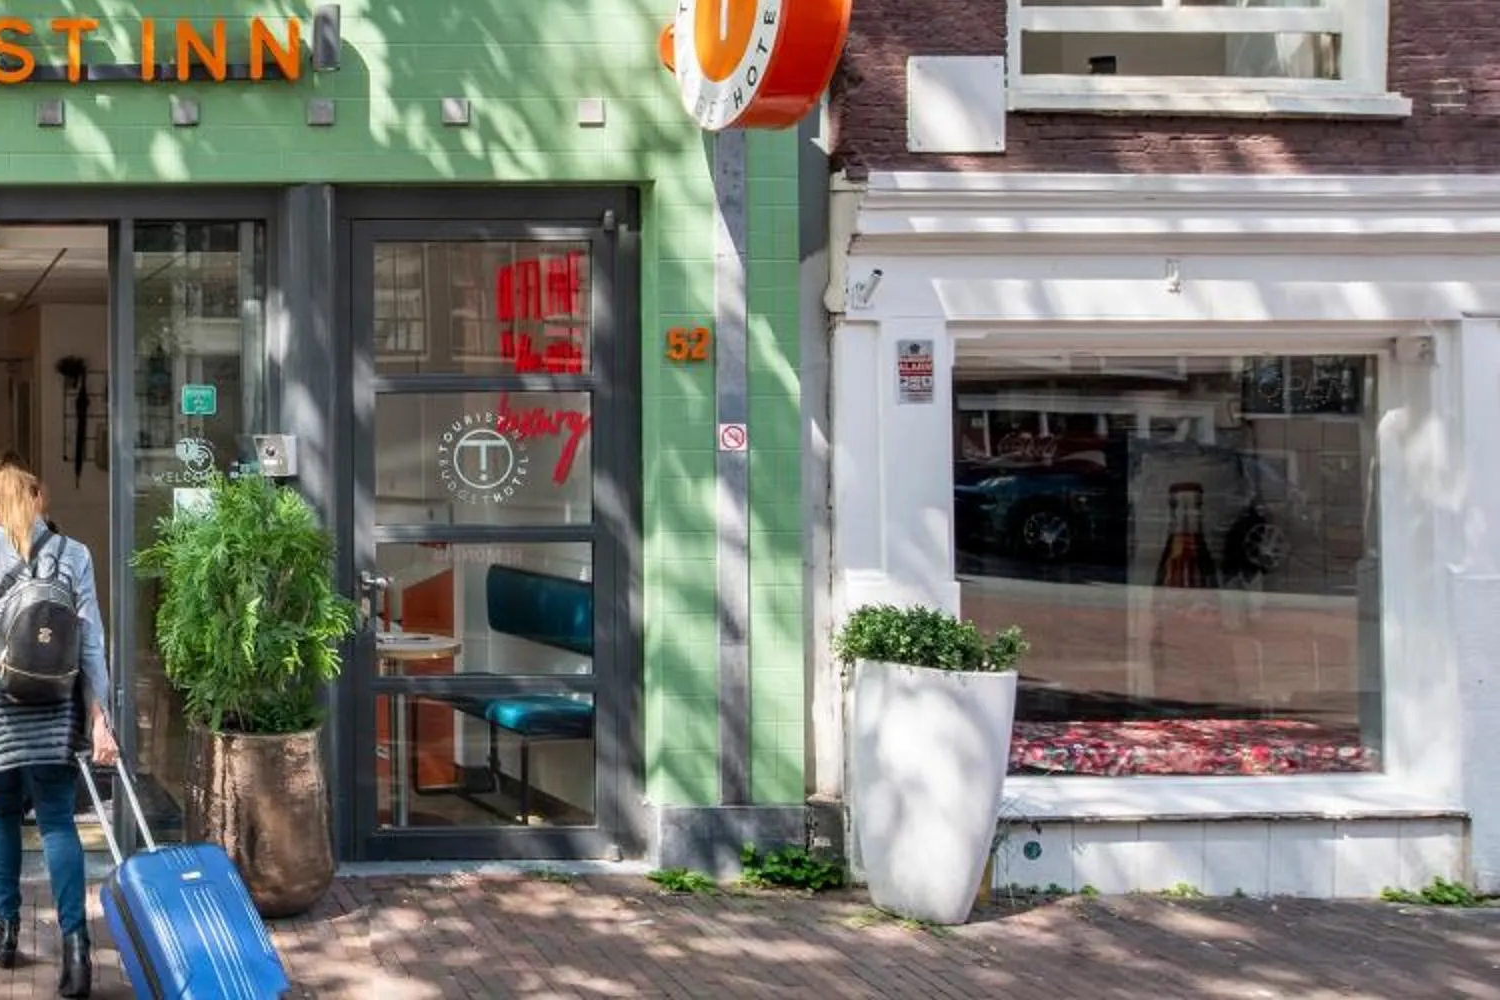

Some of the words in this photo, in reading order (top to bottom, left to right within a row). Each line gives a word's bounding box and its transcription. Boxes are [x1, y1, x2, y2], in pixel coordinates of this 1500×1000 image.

[141, 18, 301, 83] INN
[667, 327, 710, 361] 52
[438, 412, 506, 453] TOURIST
[493, 455, 530, 504] HOTEL
